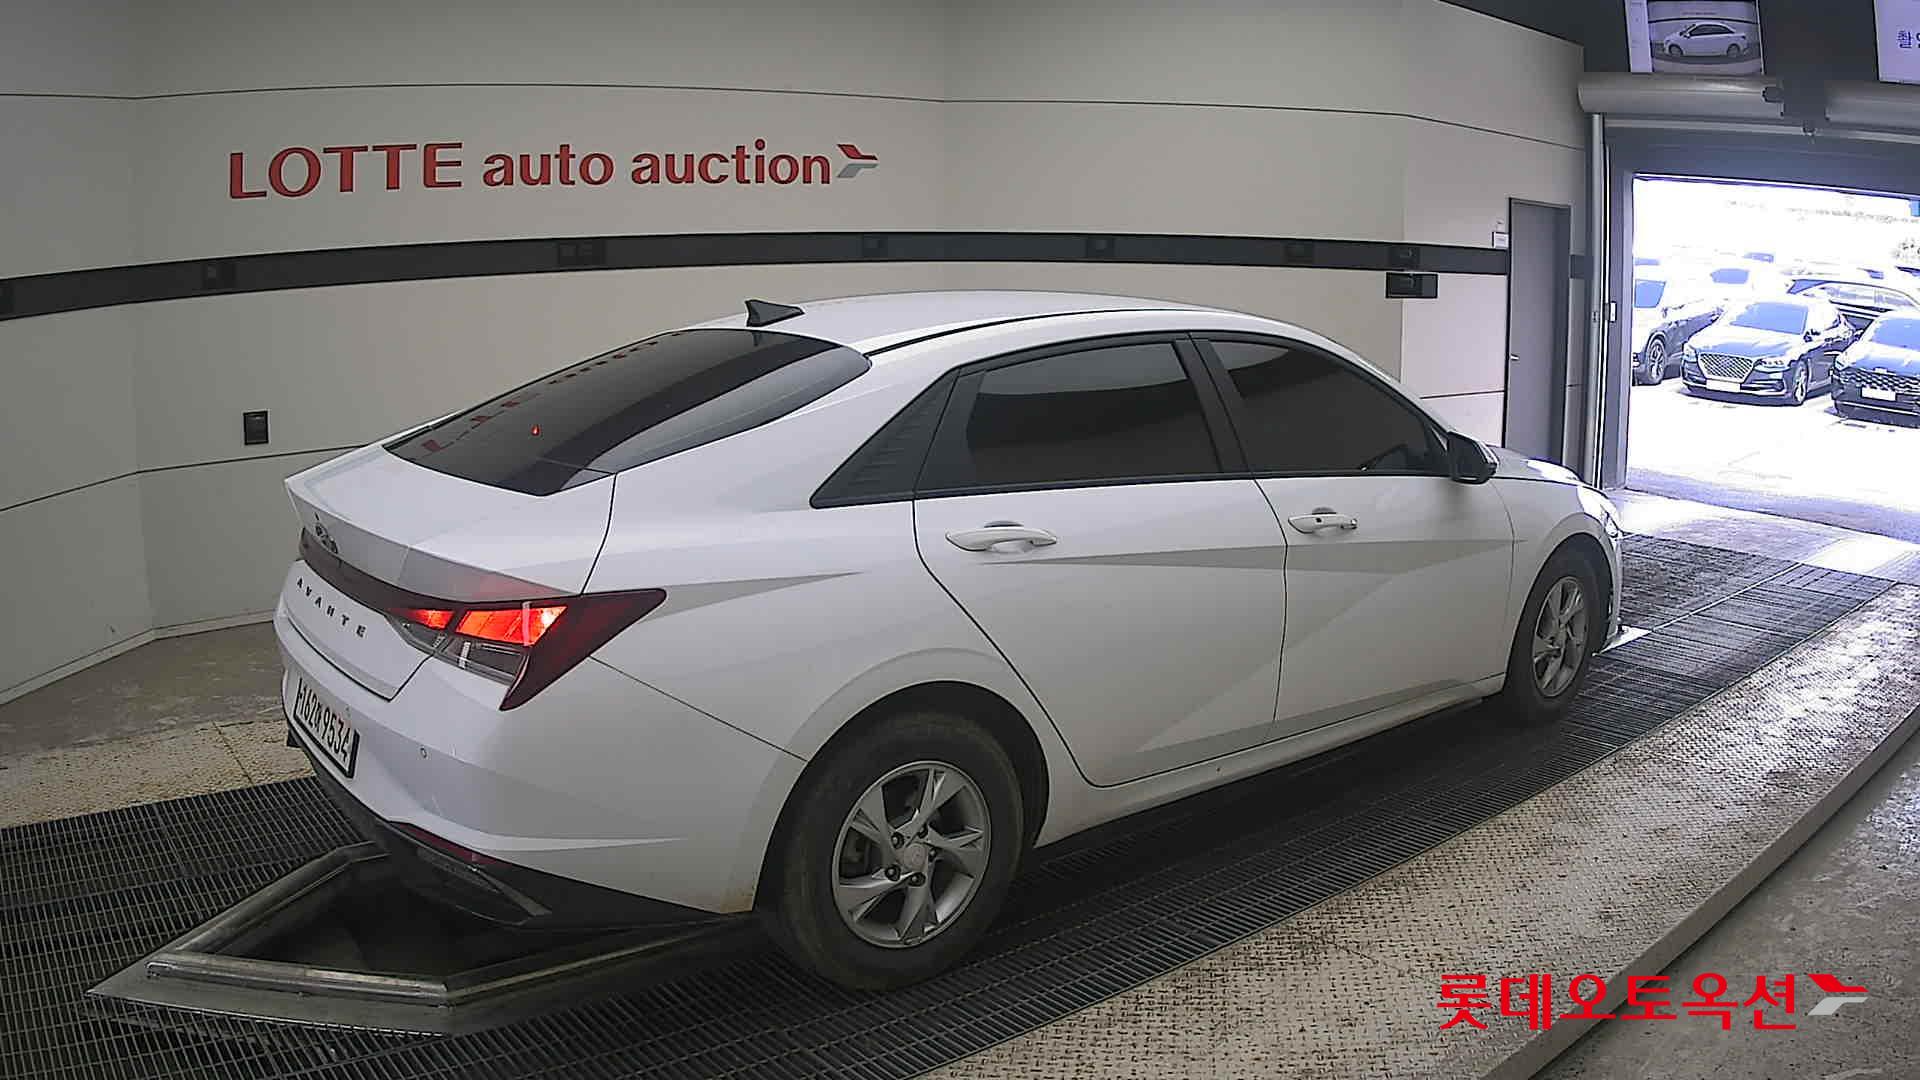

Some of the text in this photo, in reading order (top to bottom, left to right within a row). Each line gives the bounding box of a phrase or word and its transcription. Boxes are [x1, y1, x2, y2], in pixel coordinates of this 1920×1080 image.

[229, 139, 831, 199] LOTTE auto auction
[296, 577, 367, 638] AVANTE
[321, 706, 352, 763] 9534
